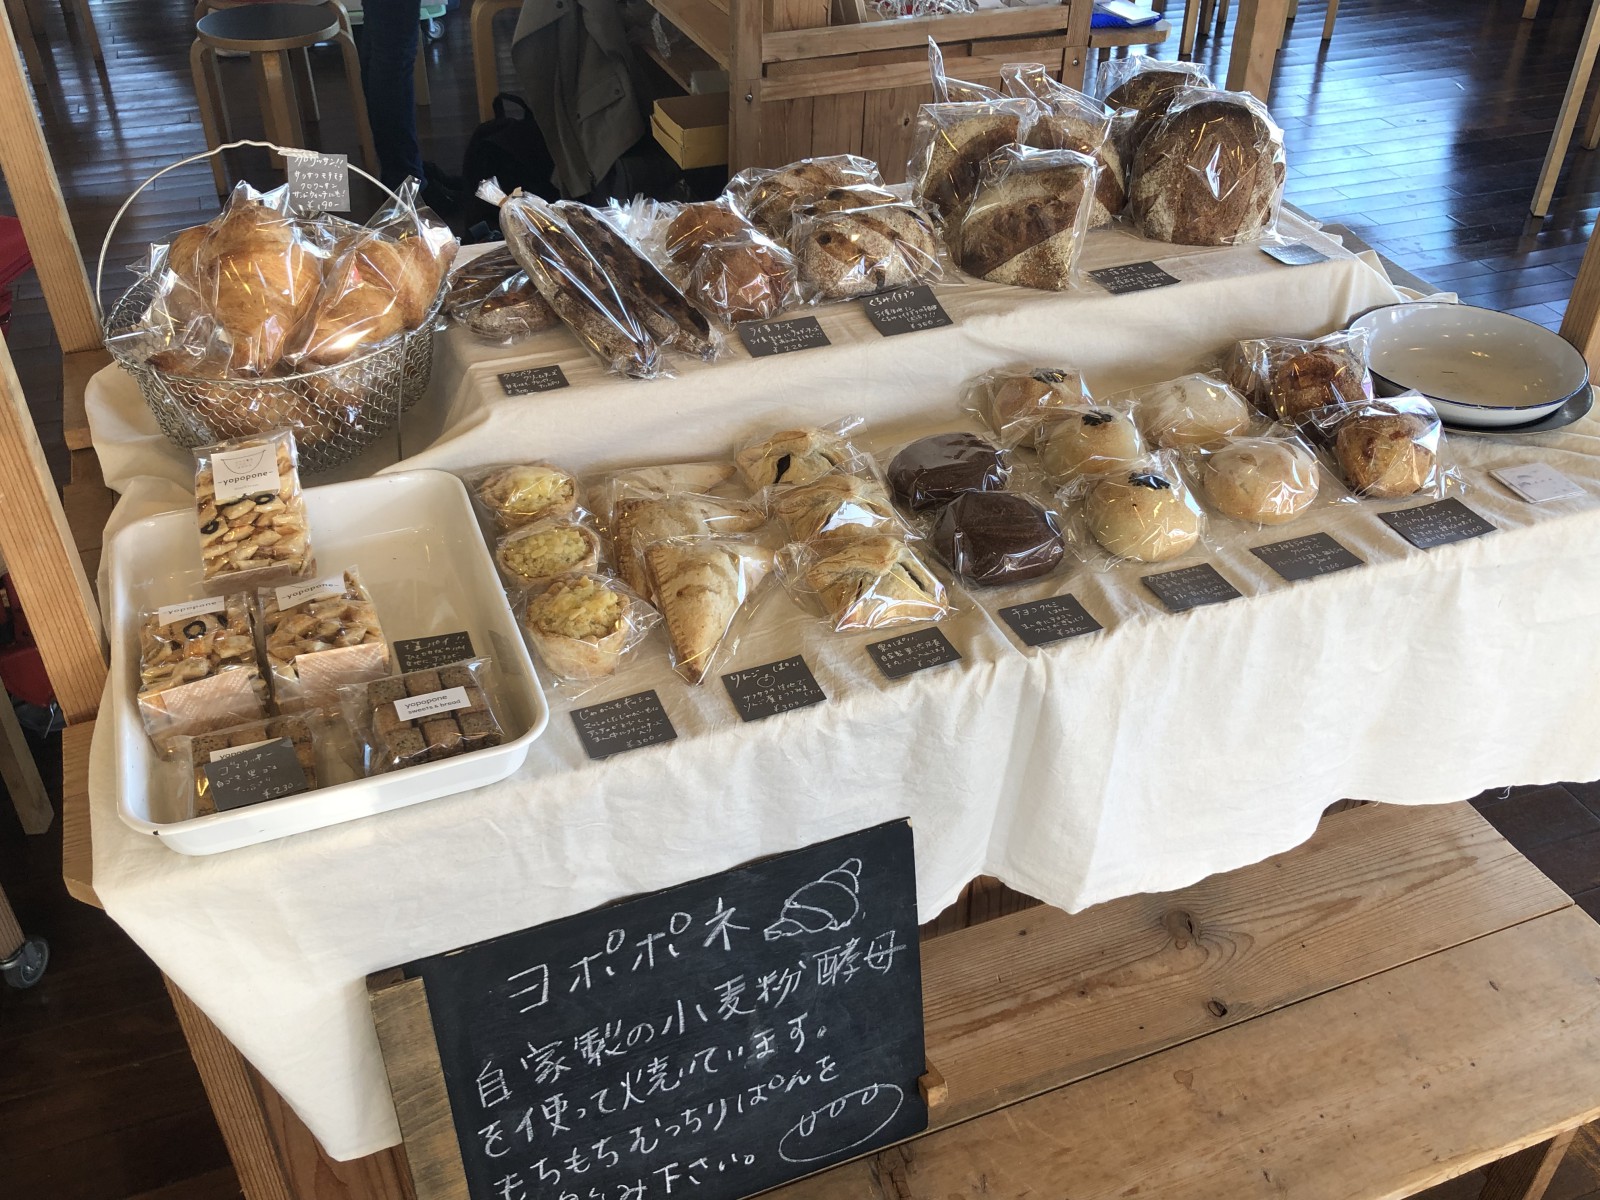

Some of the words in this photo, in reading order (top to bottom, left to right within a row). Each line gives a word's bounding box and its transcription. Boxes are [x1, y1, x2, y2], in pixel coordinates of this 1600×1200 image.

[223, 471, 268, 486] yopopone
[288, 583, 334, 599] yopopone
[168, 601, 217, 614] yopopone
[404, 695, 448, 709] yopopone
[408, 705, 433, 714] sweets
[440, 699, 461, 708] bread
[508, 897, 750, 1013] ヨポポネ
[476, 929, 907, 1108] 自家製の小麦粉酵母
[478, 1011, 828, 1157] を使って焼いています。
[493, 1055, 840, 1200] もちもちむっちりぱんを
